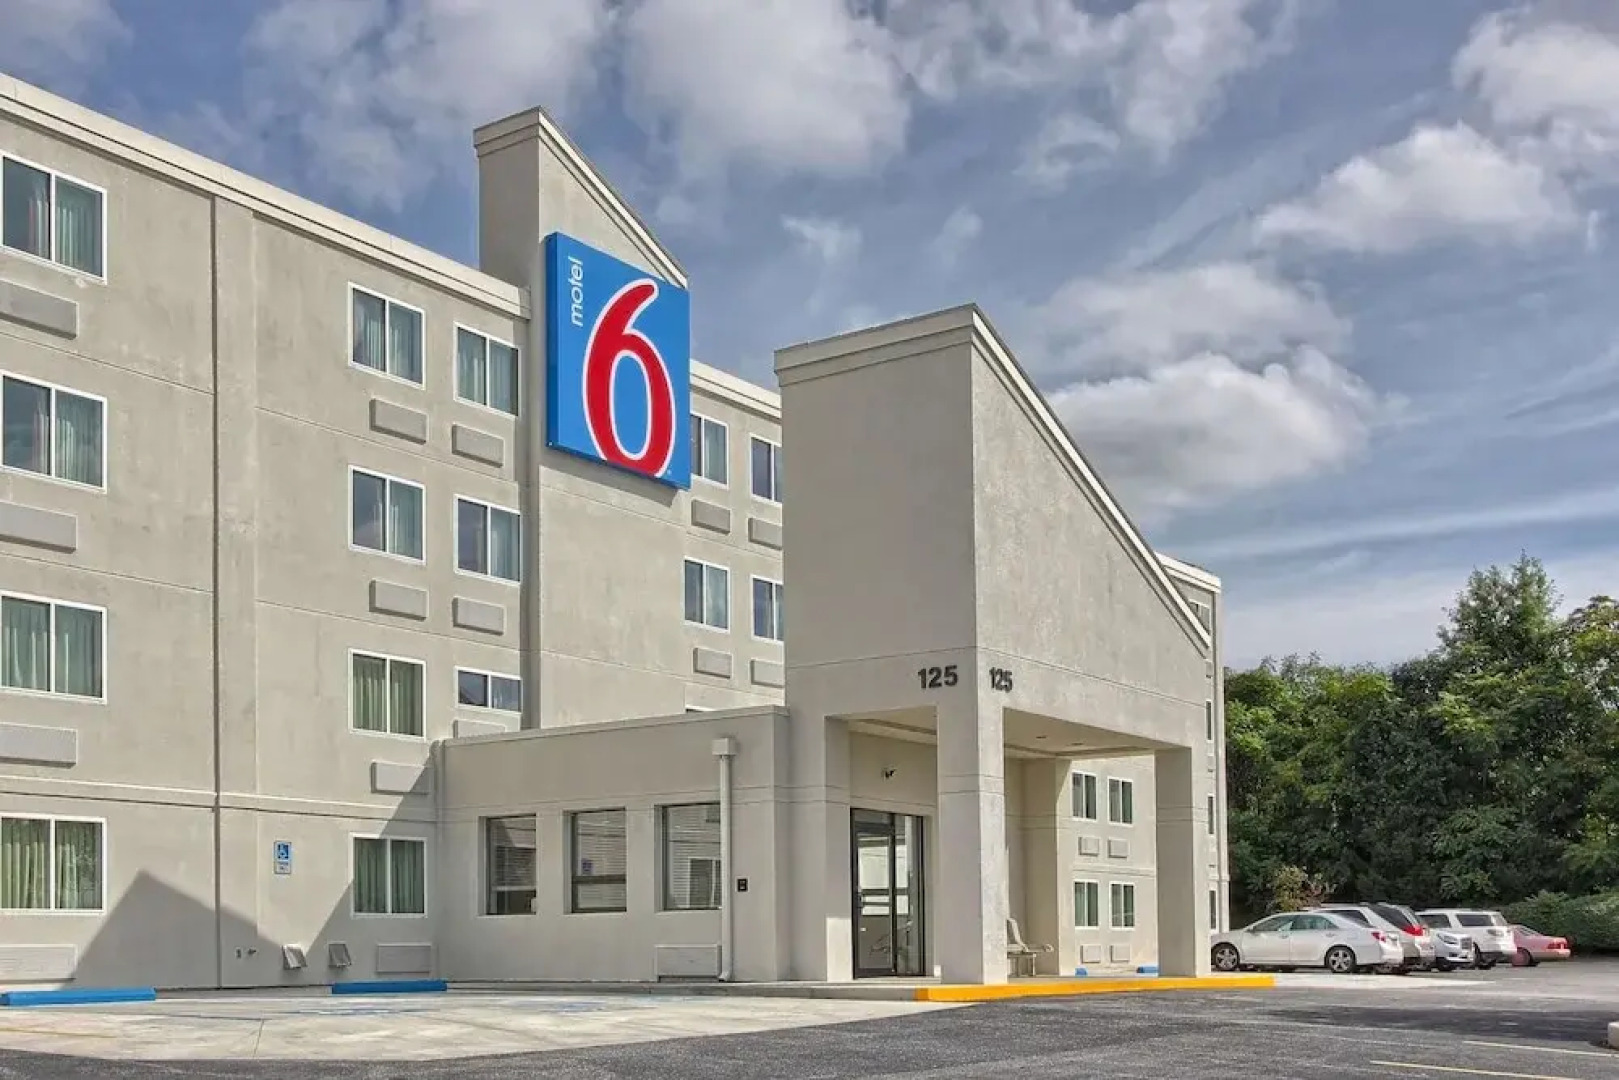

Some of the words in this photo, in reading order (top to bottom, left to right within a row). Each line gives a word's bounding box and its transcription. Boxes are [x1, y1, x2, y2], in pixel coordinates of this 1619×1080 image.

[568, 255, 584, 328] motel
[582, 278, 676, 478] 6
[917, 664, 958, 689] 125
[988, 666, 1013, 693] 125
